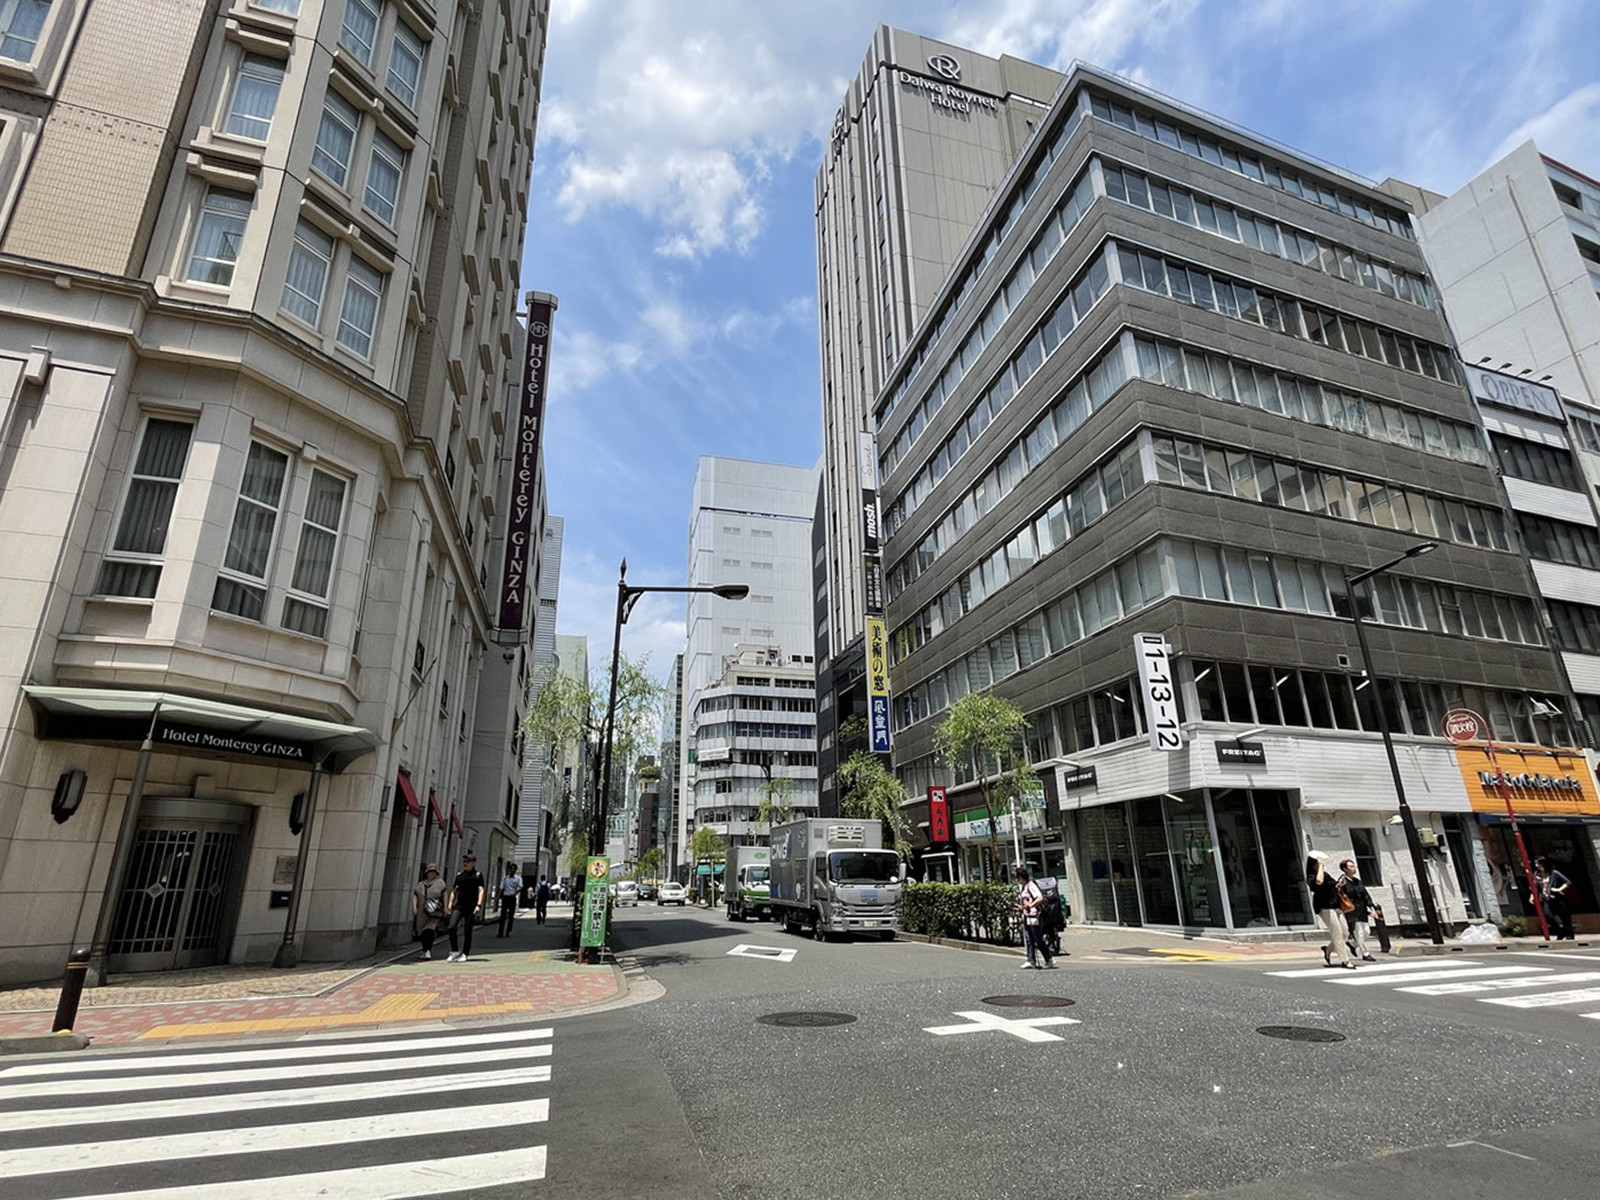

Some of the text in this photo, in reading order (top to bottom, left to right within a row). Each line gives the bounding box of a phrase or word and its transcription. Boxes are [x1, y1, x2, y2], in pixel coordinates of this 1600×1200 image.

[900, 71, 998, 110] Daiwa Roynet
[931, 92, 970, 113] Hotel
[506, 343, 543, 604] Hotel Monterey GINZA
[872, 625, 885, 692] 美術の窓
[163, 728, 303, 757] Hotel Monterey GINZA
